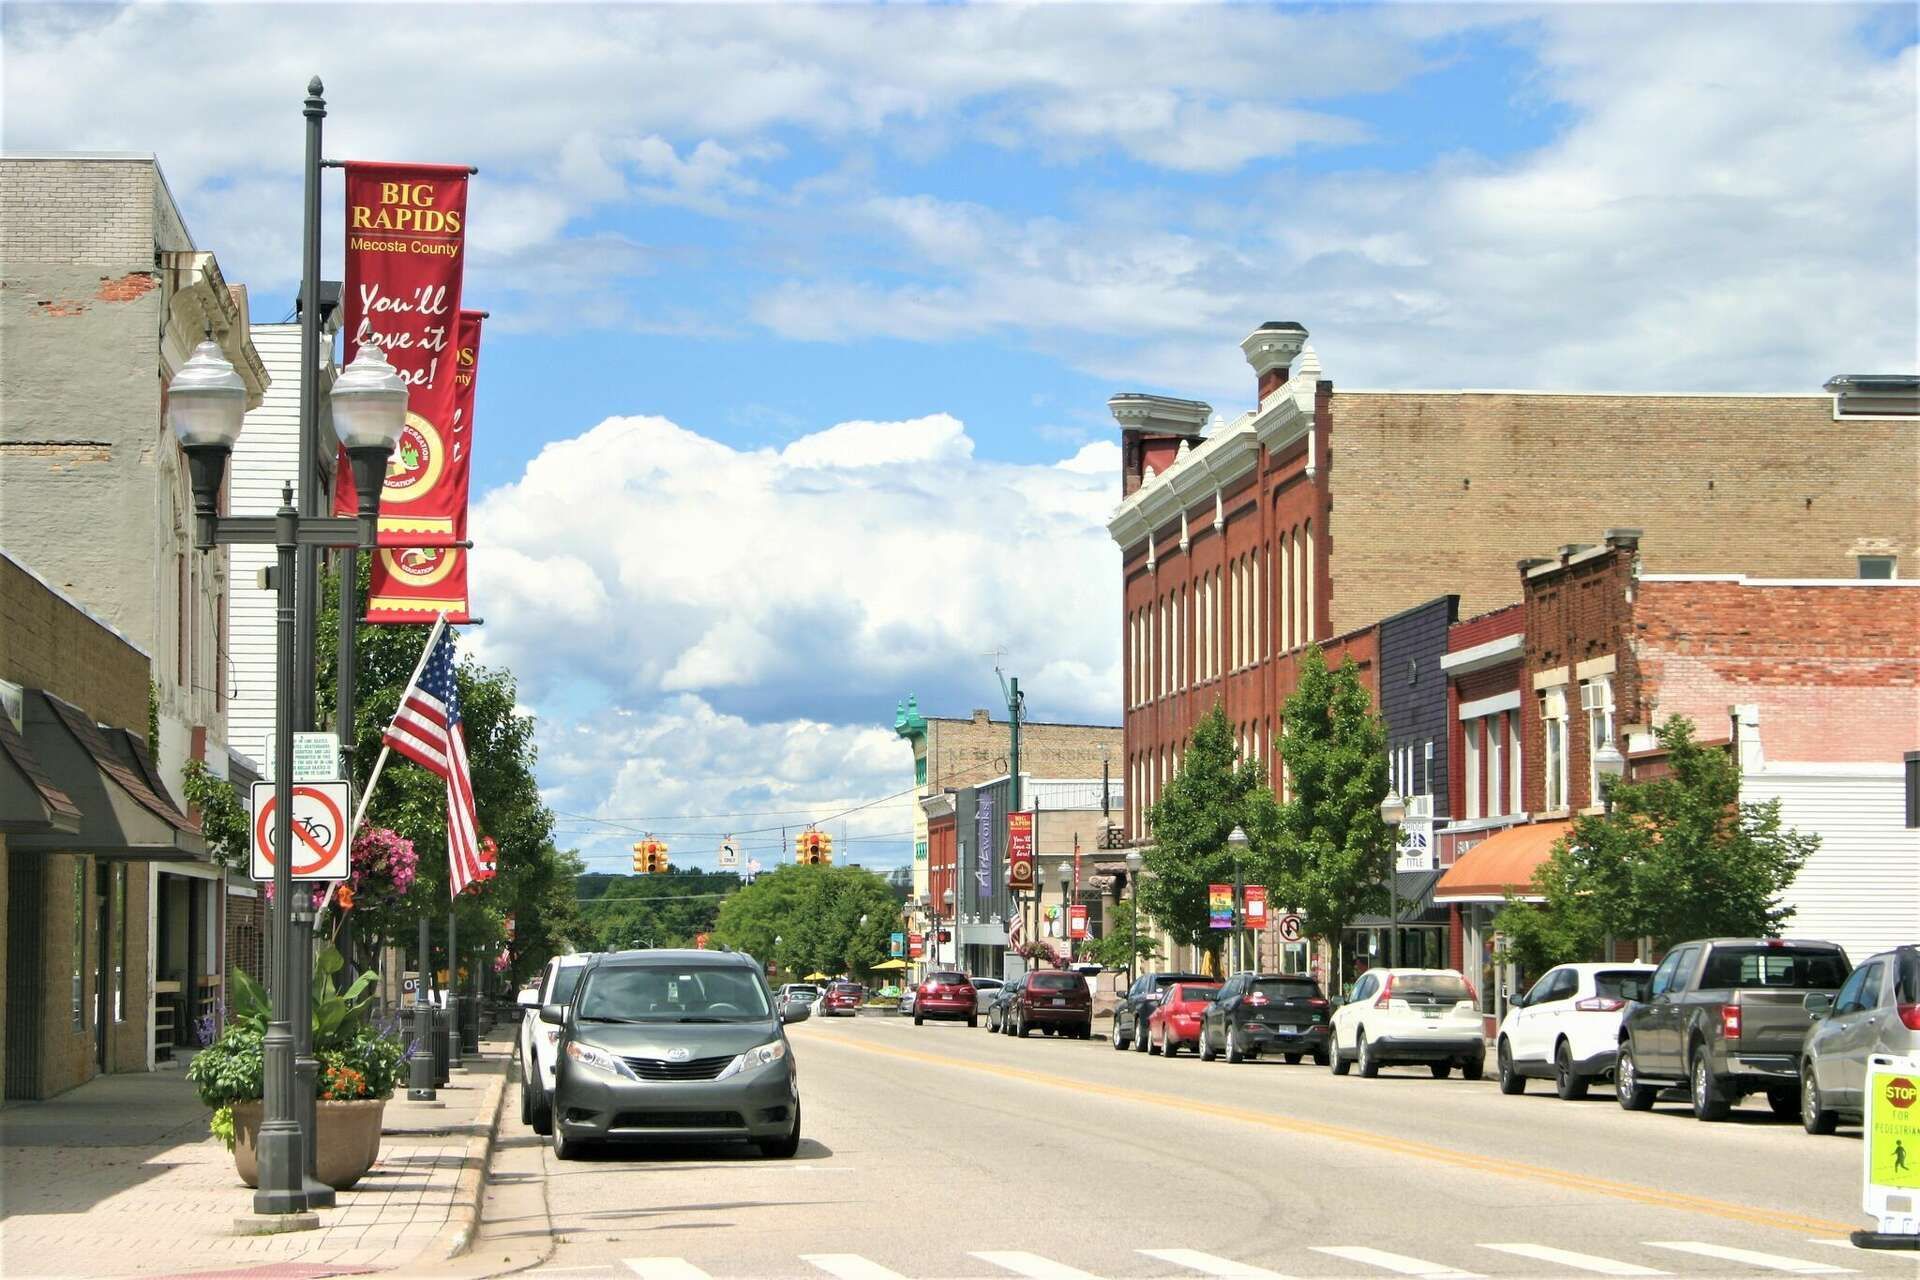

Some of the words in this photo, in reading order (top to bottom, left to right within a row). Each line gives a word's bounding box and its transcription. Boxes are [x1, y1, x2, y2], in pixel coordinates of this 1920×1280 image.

[380, 182, 435, 207] BIG
[352, 206, 461, 233] RAPIDS
[351, 238, 407, 253] Mecosta
[411, 241, 458, 258] County
[360, 283, 448, 315] You'll
[352, 316, 414, 349] love
[417, 325, 448, 352] it
[1406, 858, 1424, 867] TITLE
[1886, 1086, 1917, 1100] STOP
[1892, 1110, 1909, 1121] FOR
